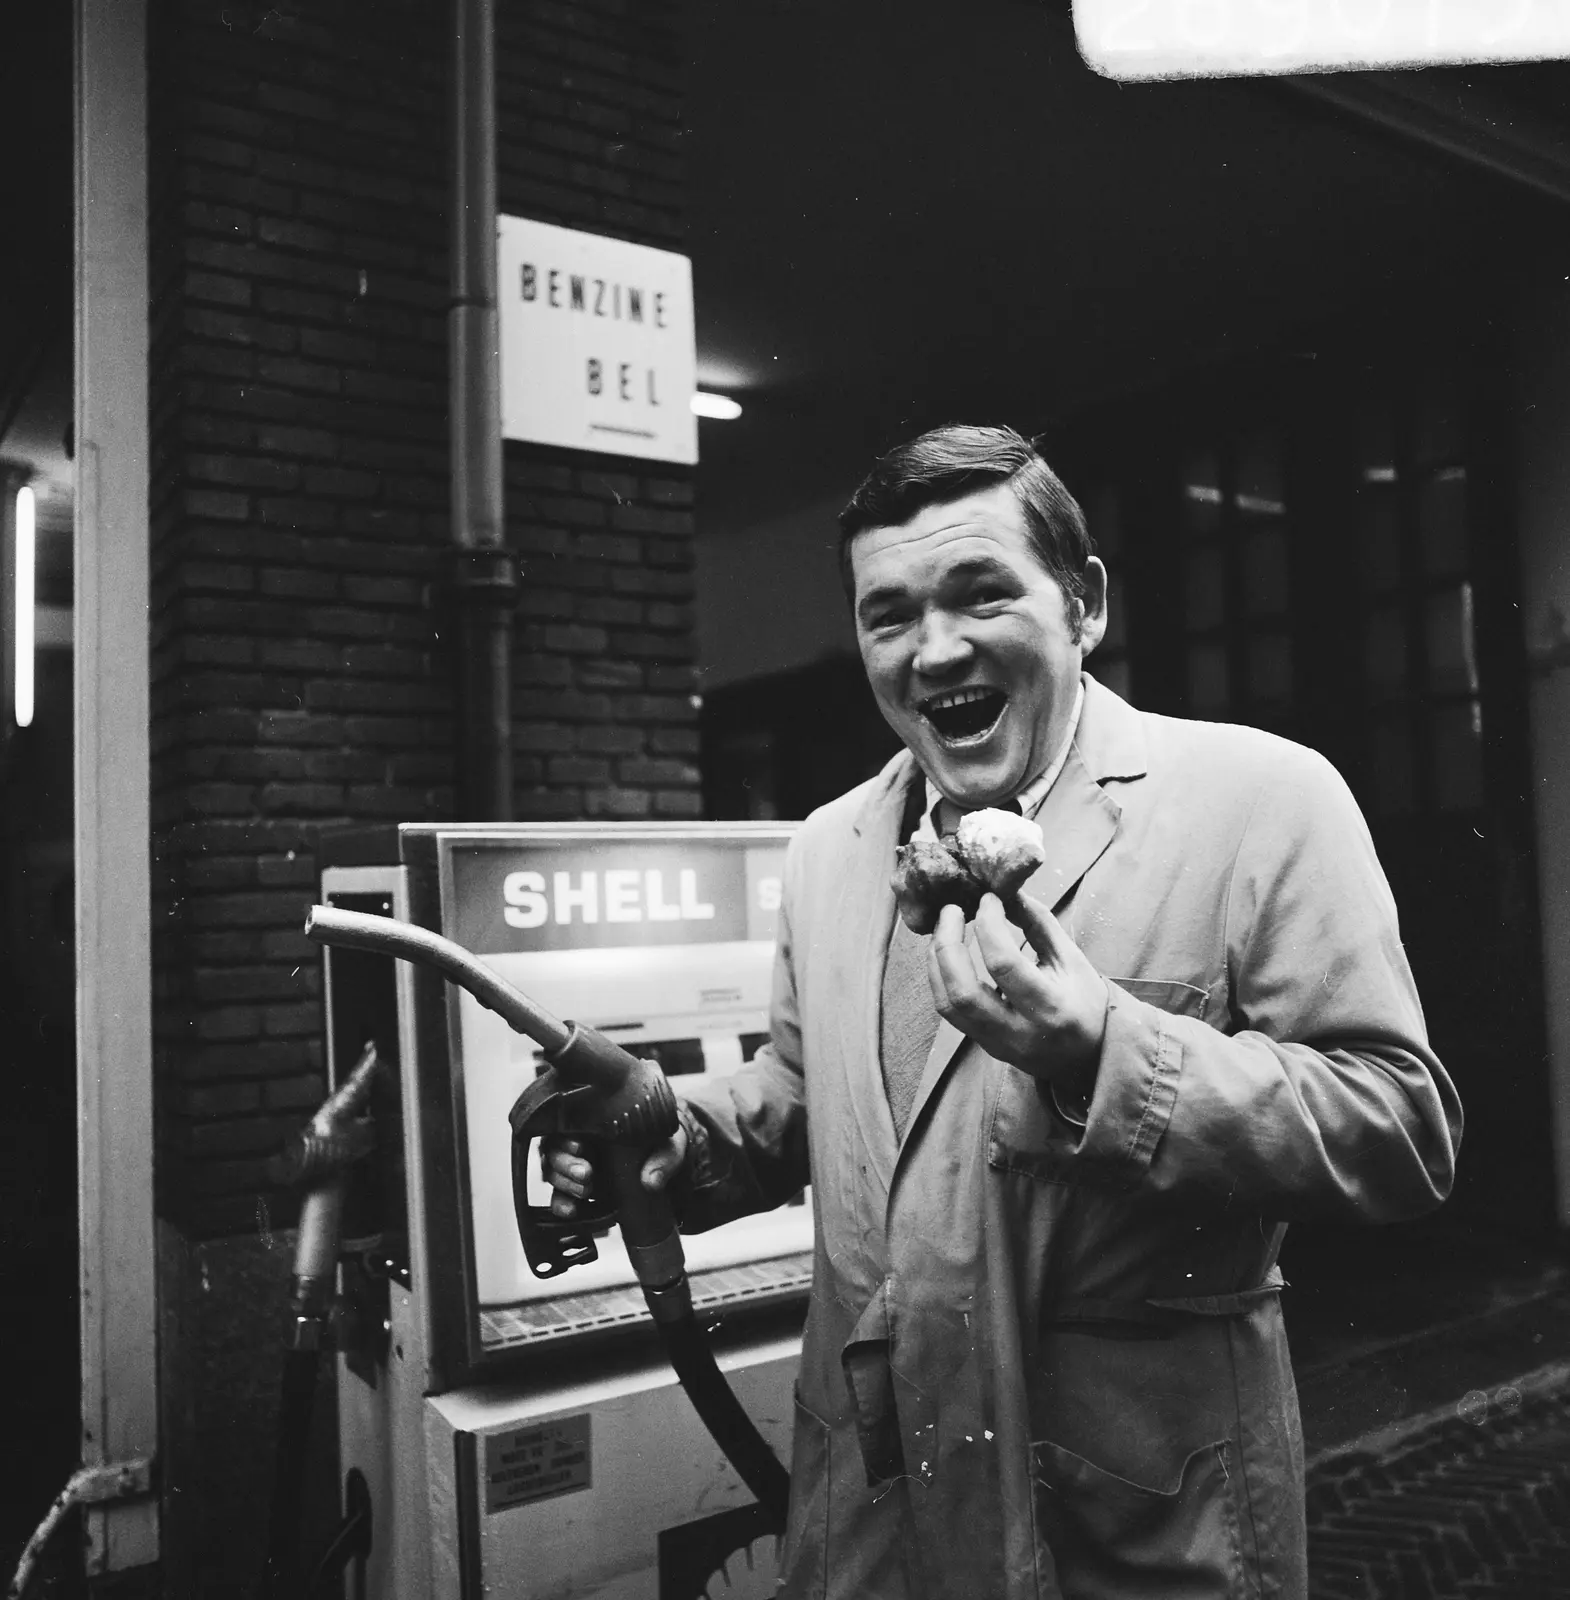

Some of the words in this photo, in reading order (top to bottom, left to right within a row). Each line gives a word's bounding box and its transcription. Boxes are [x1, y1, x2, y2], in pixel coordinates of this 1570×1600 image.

[520, 263, 668, 329] BENZINE
[587, 357, 661, 406] BEL
[503, 869, 715, 929] SHELL
